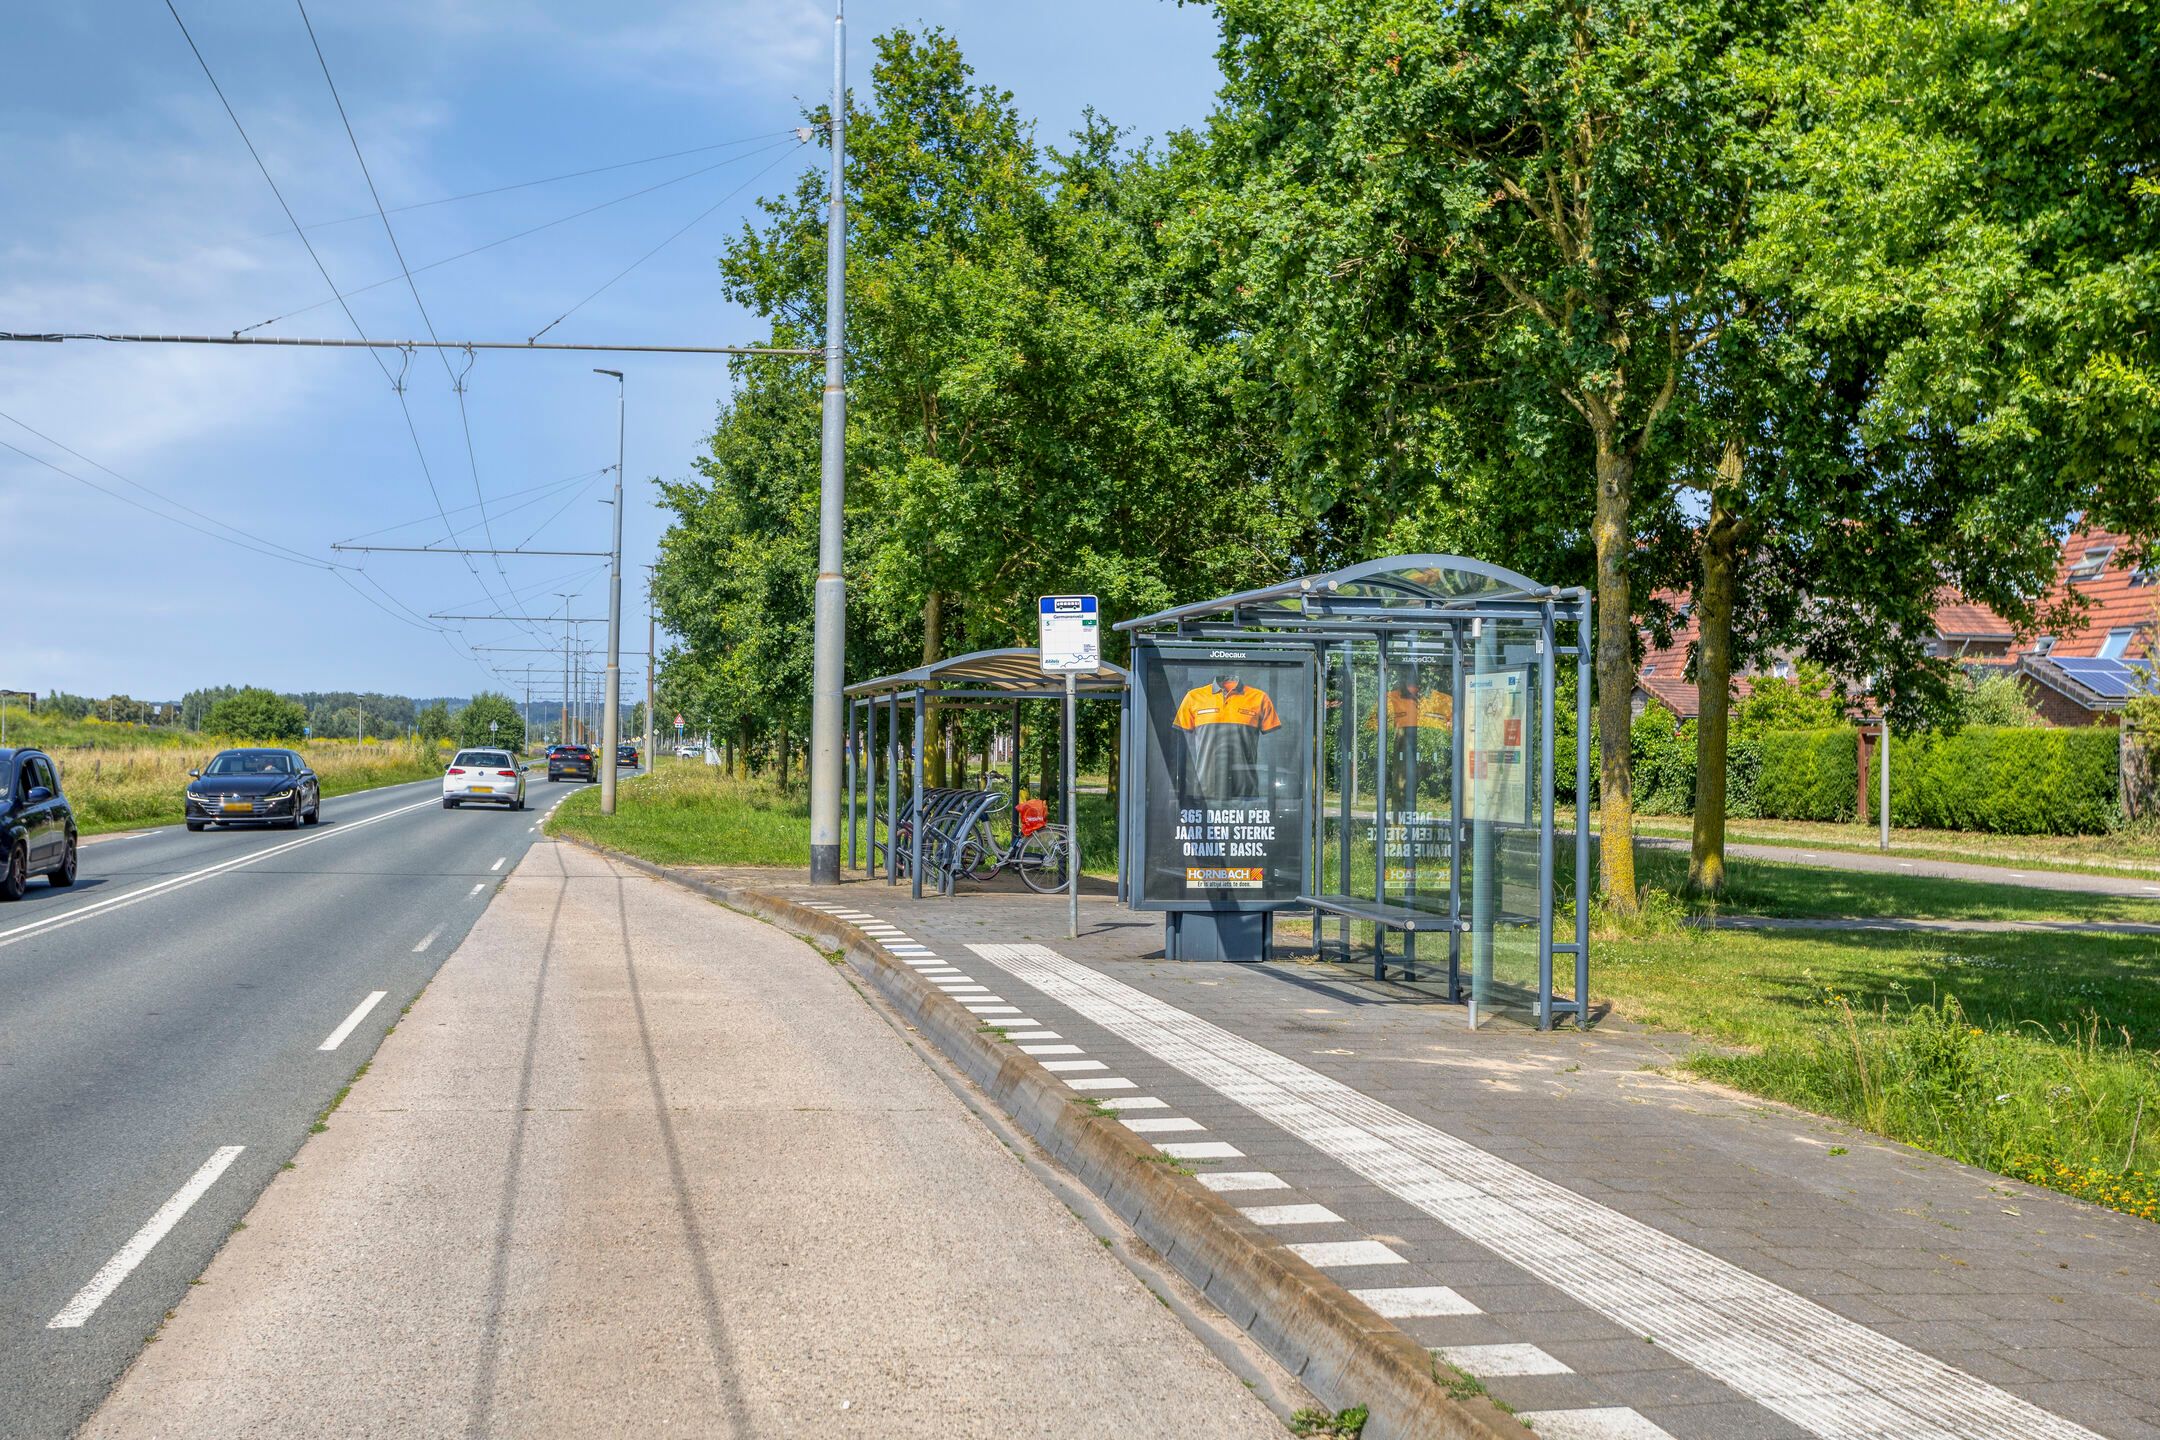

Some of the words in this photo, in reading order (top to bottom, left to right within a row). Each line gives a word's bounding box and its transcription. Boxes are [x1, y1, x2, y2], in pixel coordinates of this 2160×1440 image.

[1180, 809, 1202, 823] 365
[1207, 809, 1244, 823] DAGEN
[1248, 809, 1270, 823] PER
[1175, 826, 1203, 840] JAAR
[1207, 826, 1229, 840] EEN
[1233, 826, 1275, 840] STERKE
[1183, 842, 1226, 856] ORANJE
[1230, 842, 1267, 856] BASIS.
[1188, 869, 1249, 879] HORNBACH
